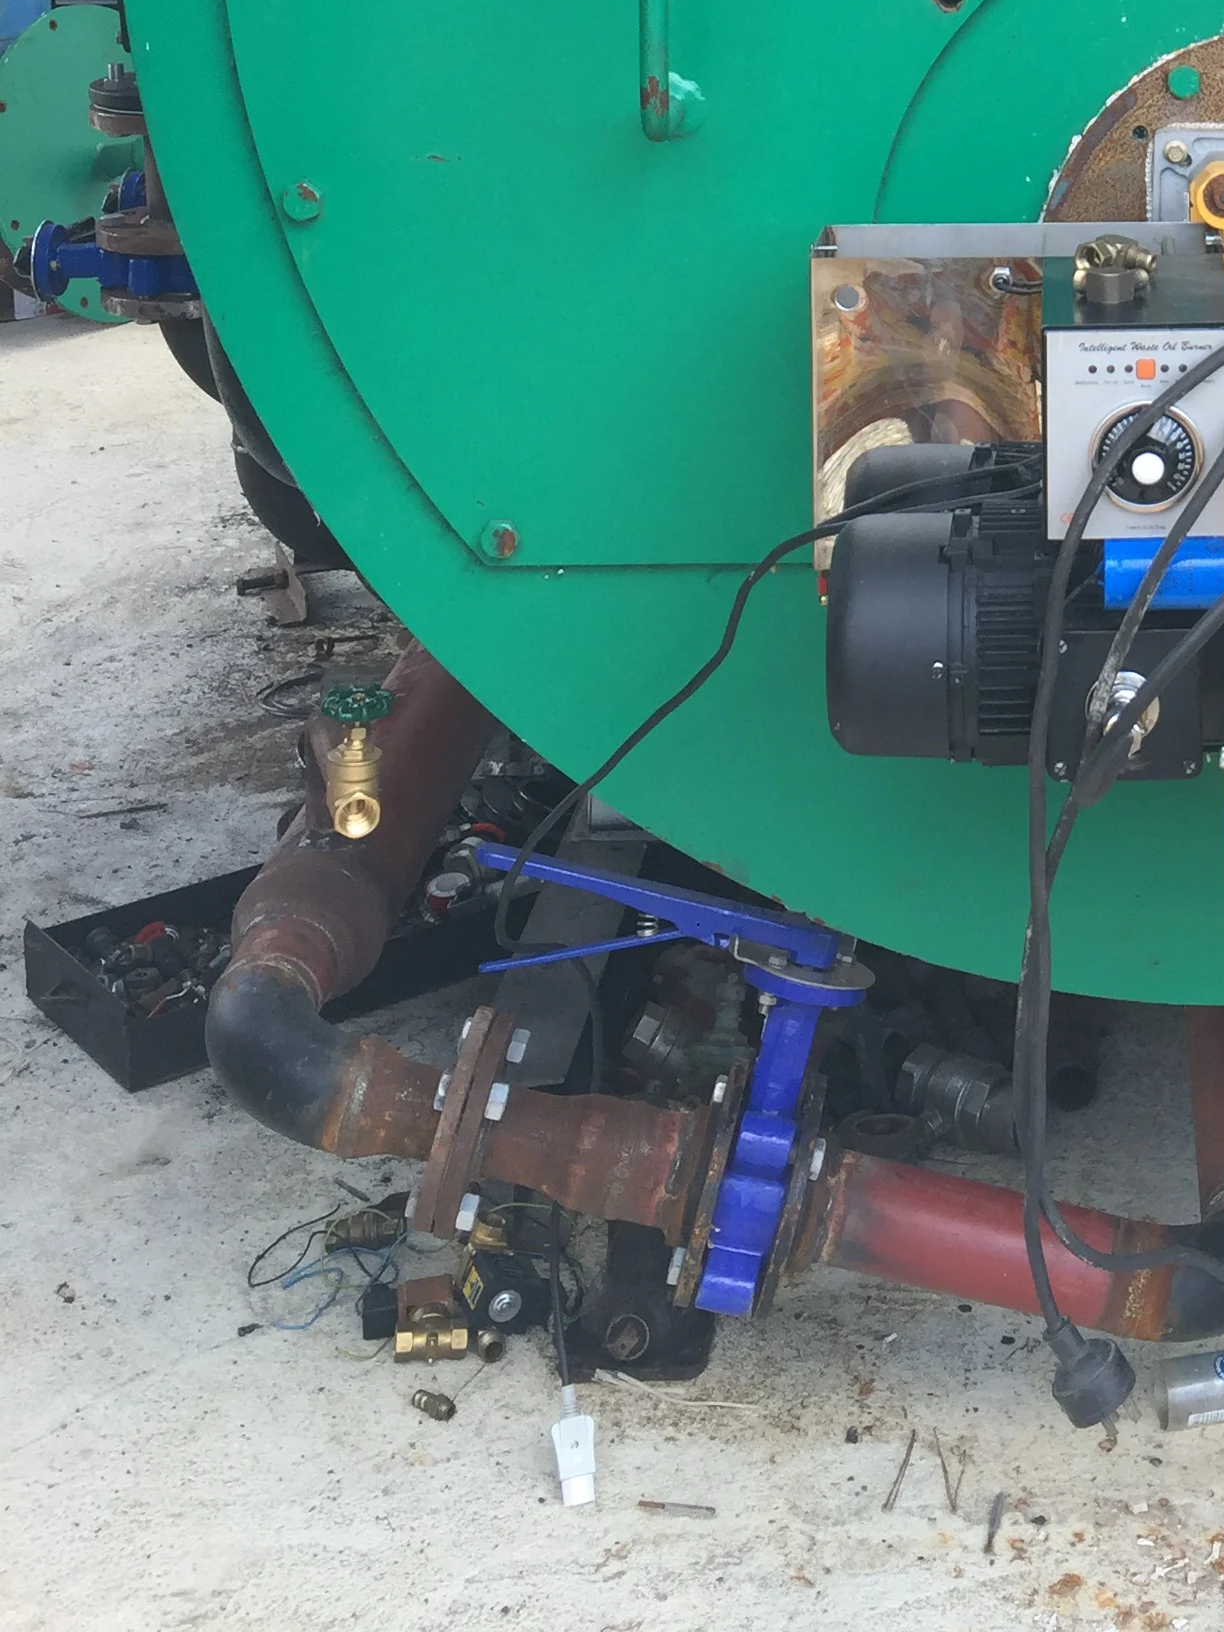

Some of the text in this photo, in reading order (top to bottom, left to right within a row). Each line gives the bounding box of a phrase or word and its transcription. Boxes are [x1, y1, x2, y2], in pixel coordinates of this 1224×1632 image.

[1078, 340, 1212, 354] Intelligent Waste Oil Burner
